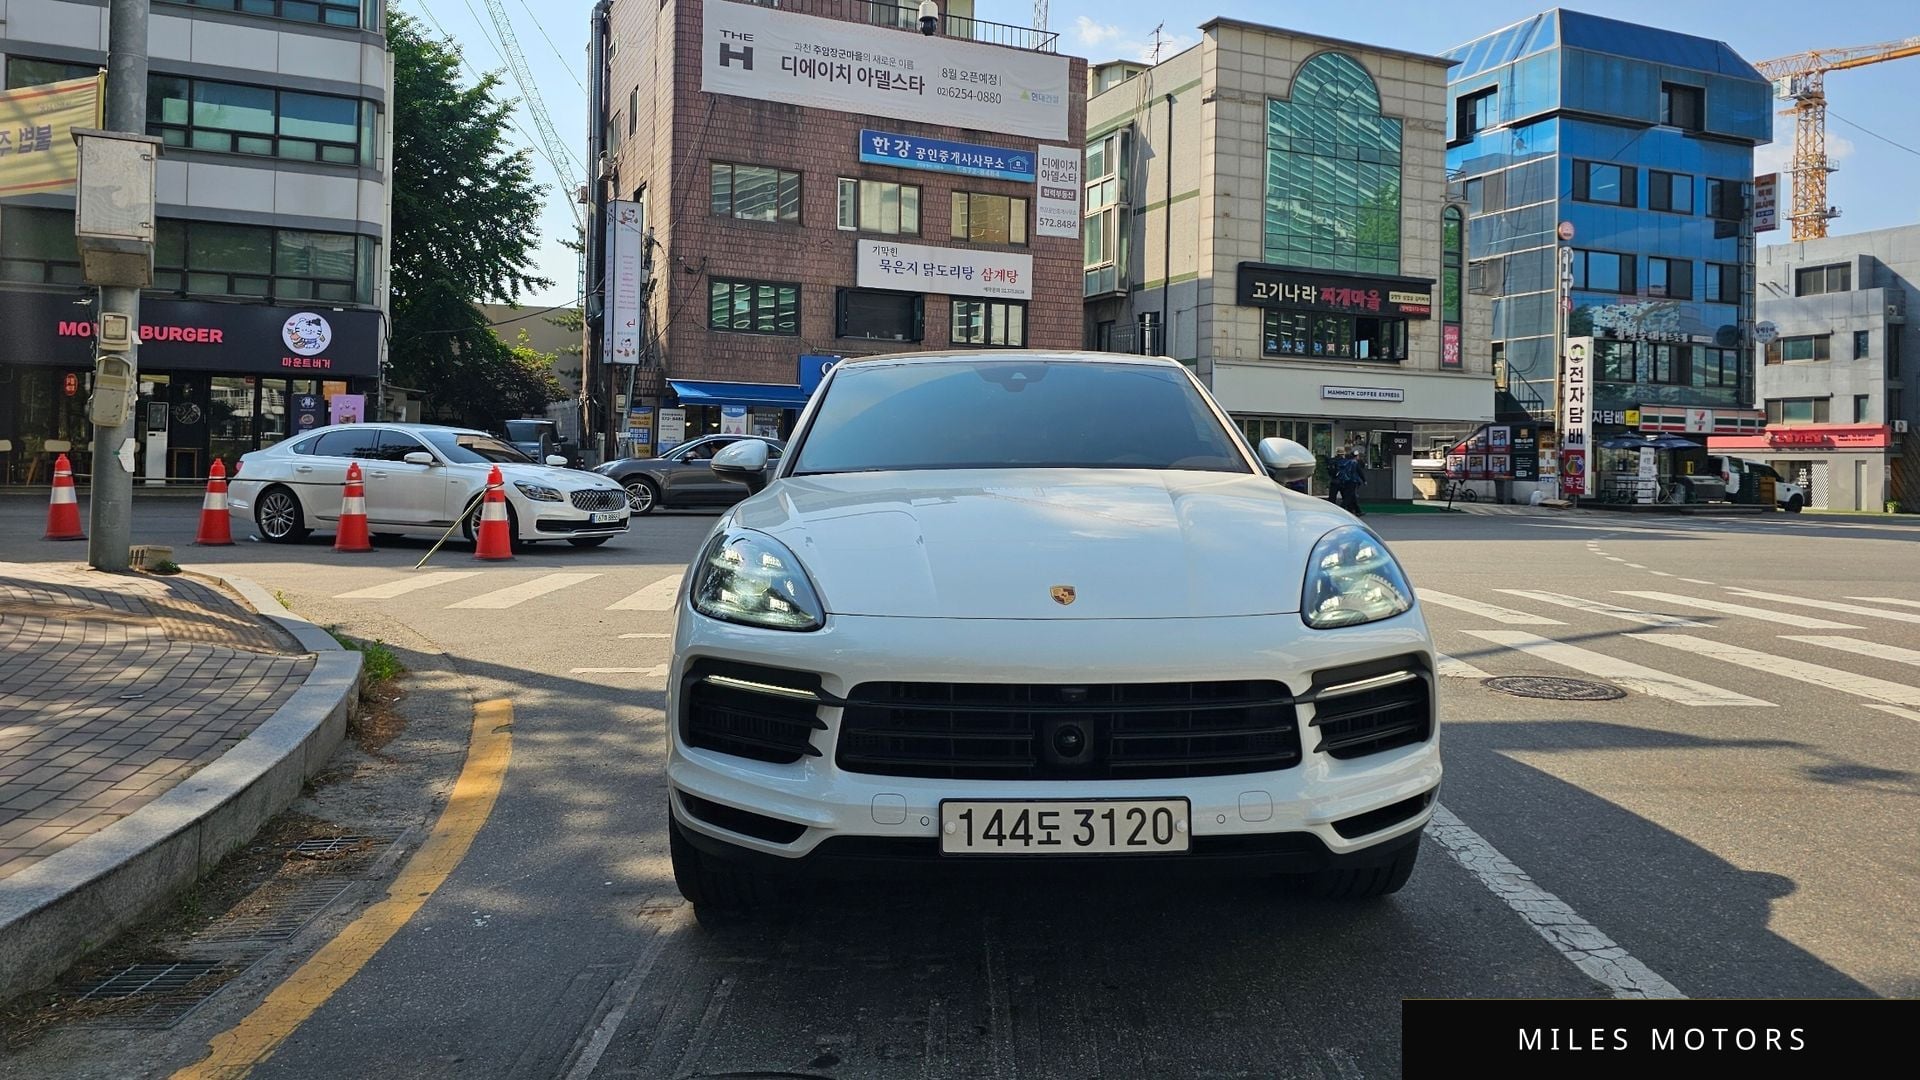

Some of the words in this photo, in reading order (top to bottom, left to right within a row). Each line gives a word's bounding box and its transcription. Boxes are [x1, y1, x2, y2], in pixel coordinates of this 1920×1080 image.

[720, 30, 754, 42] THE
[720, 43, 754, 70] H
[794, 42, 811, 53] 과천
[813, 45, 871, 62] 주암장군마을의
[873, 55, 897, 67] 새로운
[898, 59, 914, 70] 이름
[781, 55, 851, 85] 디에이치
[857, 67, 925, 95] 아델스타
[942, 68, 957, 80] 8월
[960, 71, 997, 86] 오픈예정
[916, 147, 1005, 169] 공인중개사사무소
[1042, 157, 1078, 171] 디에이치
[1041, 170, 1077, 184] 아델스타
[1039, 218, 1077, 229] 572.8484
[872, 246, 898, 257] 기막힌
[879, 259, 918, 276] 묵은지
[923, 264, 974, 281] 닭도리탕
[981, 268, 1018, 284] 삼계탕
[1252, 282, 1317, 304] 고기나라
[1320, 287, 1381, 311] 찌개마을
[140, 325, 223, 343] BURGER
[282, 357, 331, 369] 마운트버거
[1327, 389, 1355, 397] MAMMOTH
[1568, 366, 1585, 445] 전자담배
[1564, 476, 1585, 490] 복권
[959, 808, 1061, 846] 144도
[1073, 807, 1173, 846] 3120
